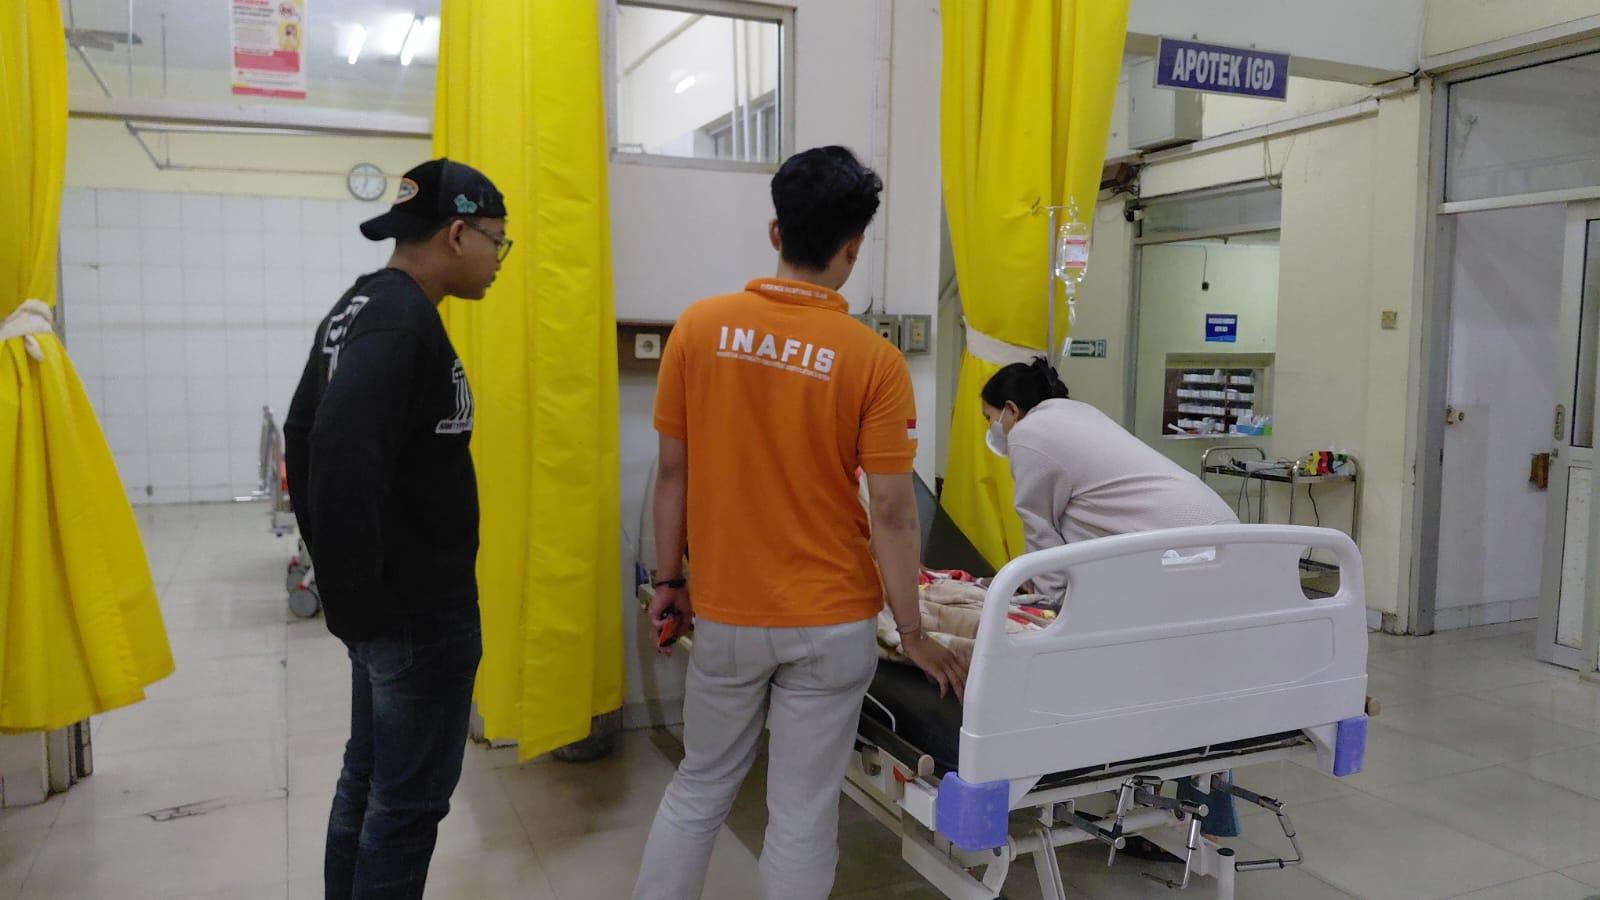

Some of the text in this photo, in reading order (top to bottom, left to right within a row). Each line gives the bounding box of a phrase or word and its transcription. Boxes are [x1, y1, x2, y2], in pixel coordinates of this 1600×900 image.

[1171, 48, 1275, 90] APOTEK IGD
[720, 326, 835, 373] INAFIS
